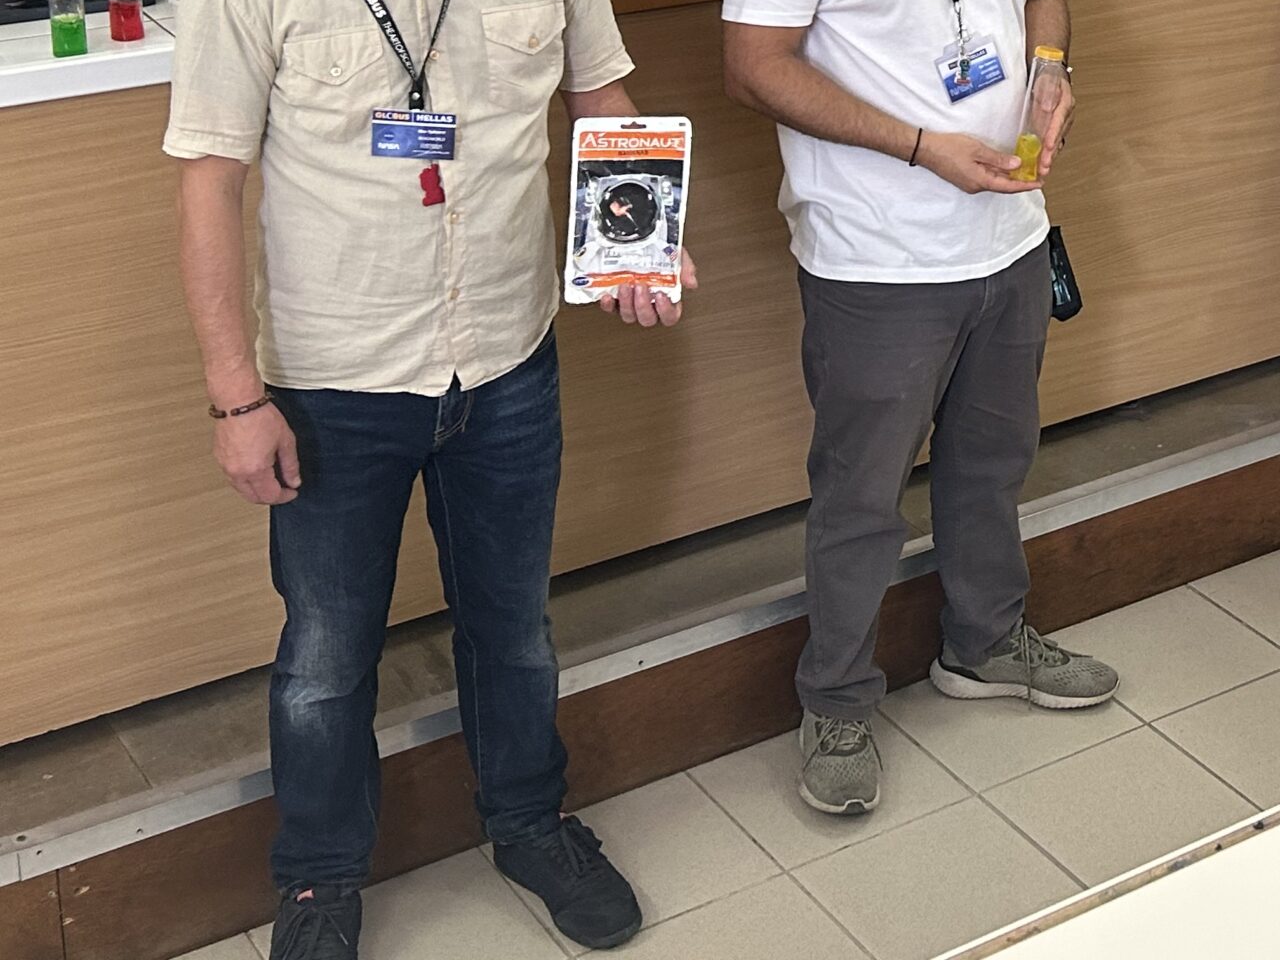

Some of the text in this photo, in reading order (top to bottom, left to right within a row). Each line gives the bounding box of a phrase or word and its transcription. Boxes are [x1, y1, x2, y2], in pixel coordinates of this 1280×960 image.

[375, 111, 453, 123] GLOBUS HELLAS
[581, 132, 684, 149] ASTRONAUT
